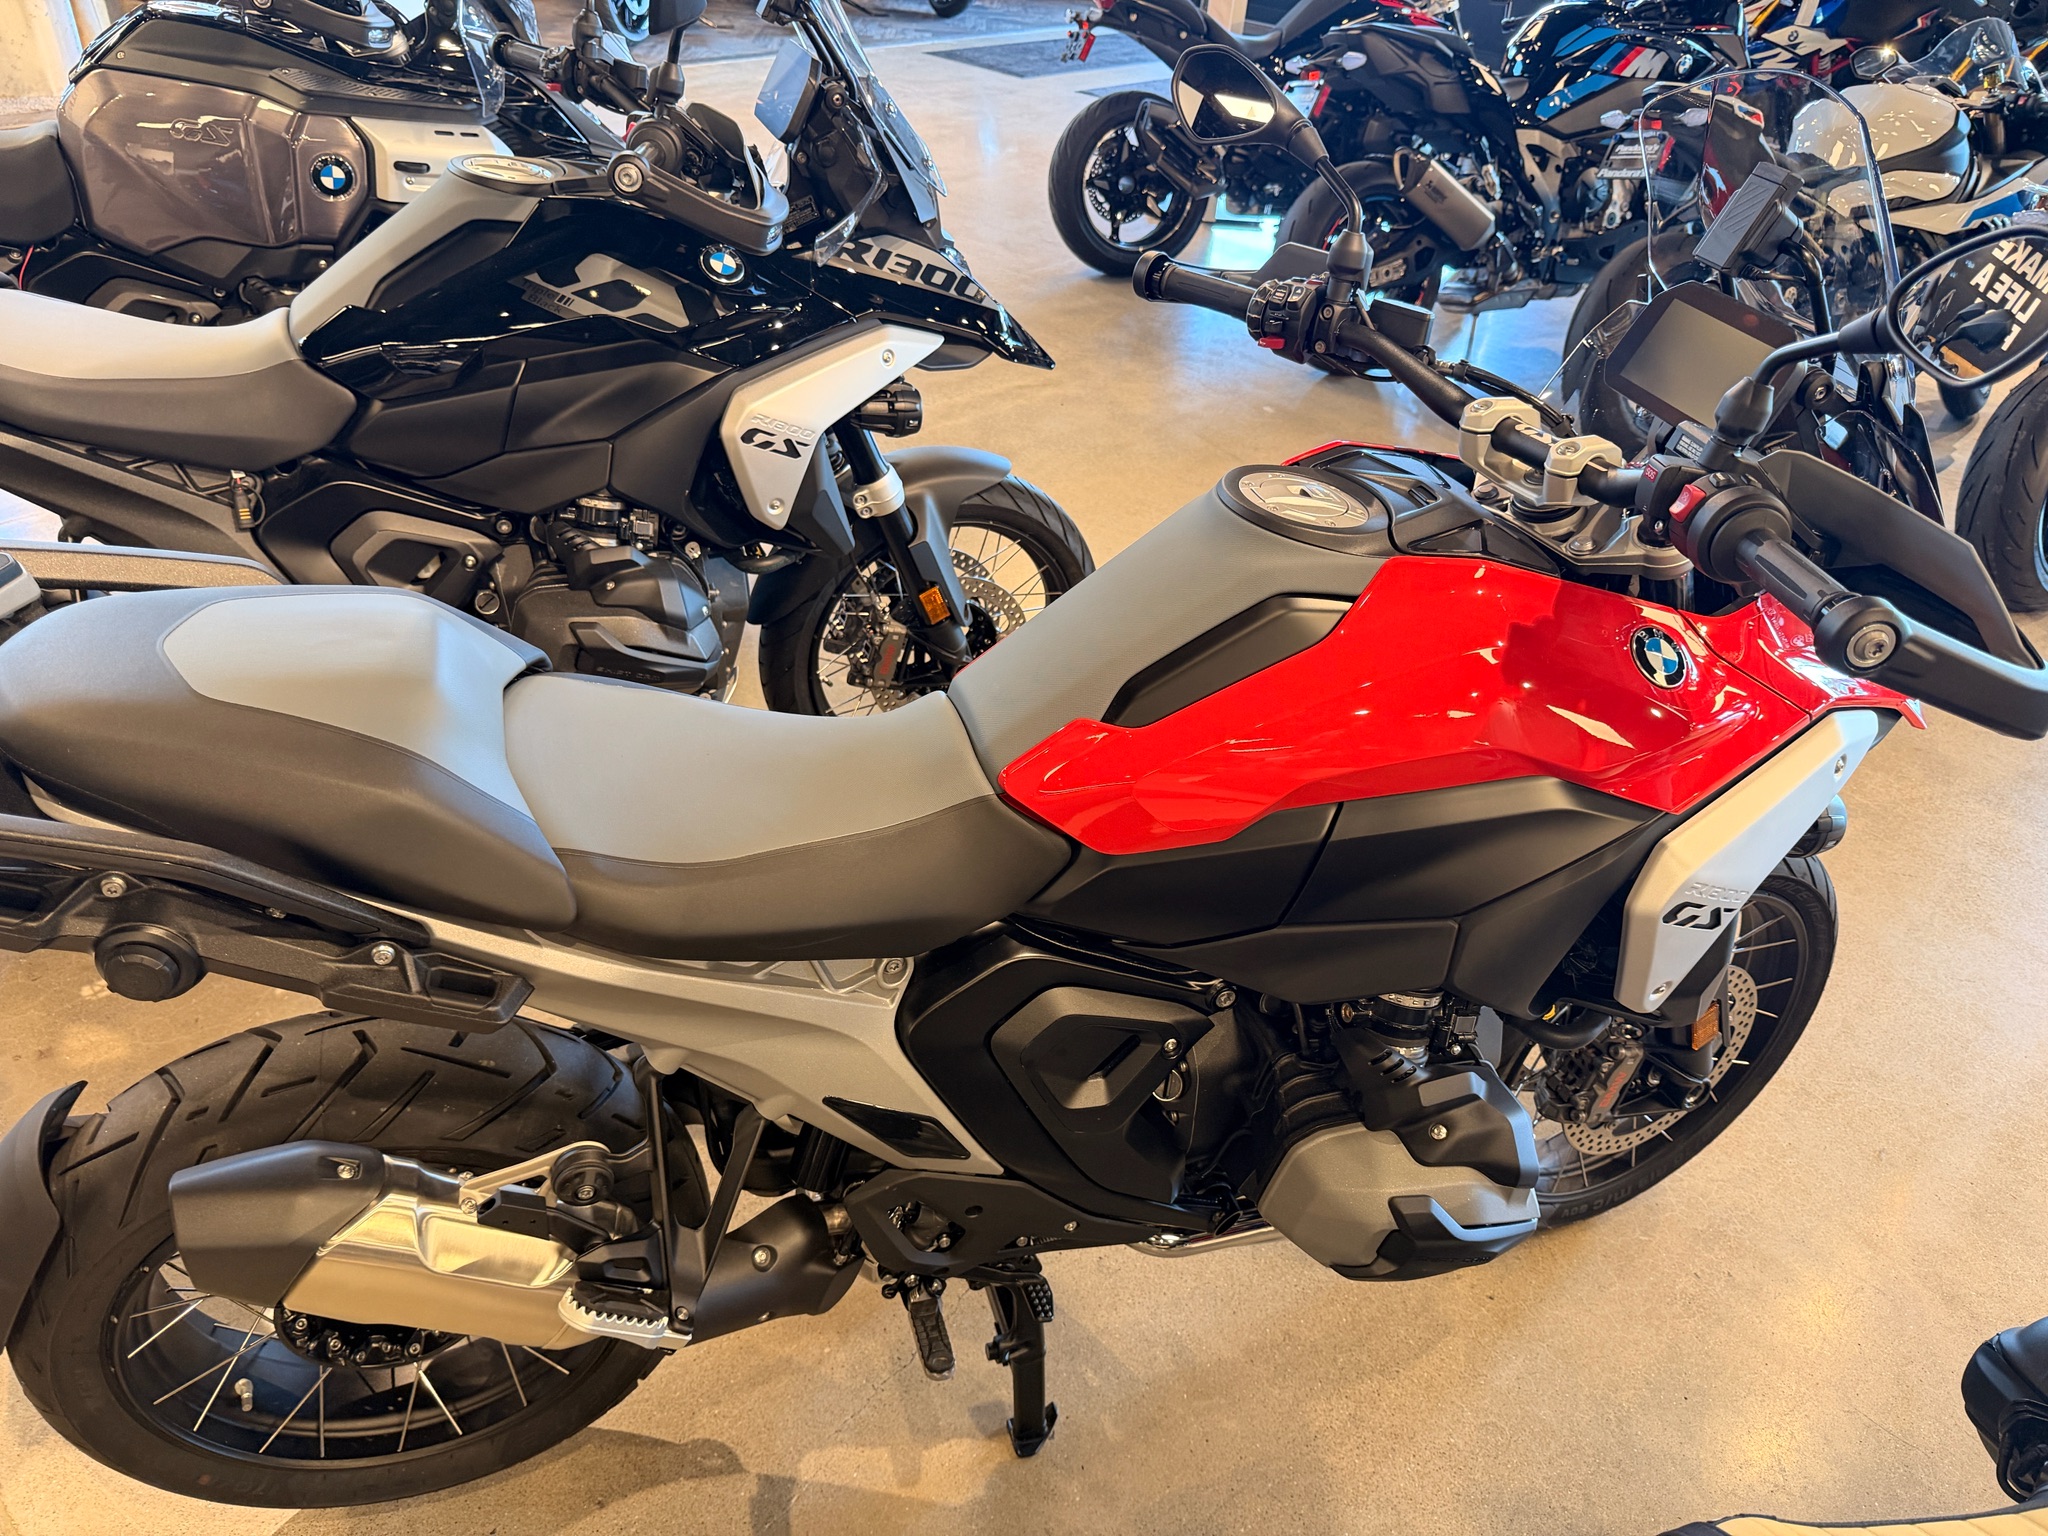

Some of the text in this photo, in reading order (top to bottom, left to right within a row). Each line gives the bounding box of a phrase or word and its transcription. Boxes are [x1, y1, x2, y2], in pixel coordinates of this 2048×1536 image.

[835, 239, 987, 305] R1300
[521, 280, 556, 299] Triple
[528, 293, 562, 314] Black
[740, 428, 811, 460] GS
[1645, 468, 1657, 480] SOS
[1638, 628, 1681, 653] BMW
[1661, 901, 1738, 931] GS
[1598, 1071, 1628, 1109] BMW
